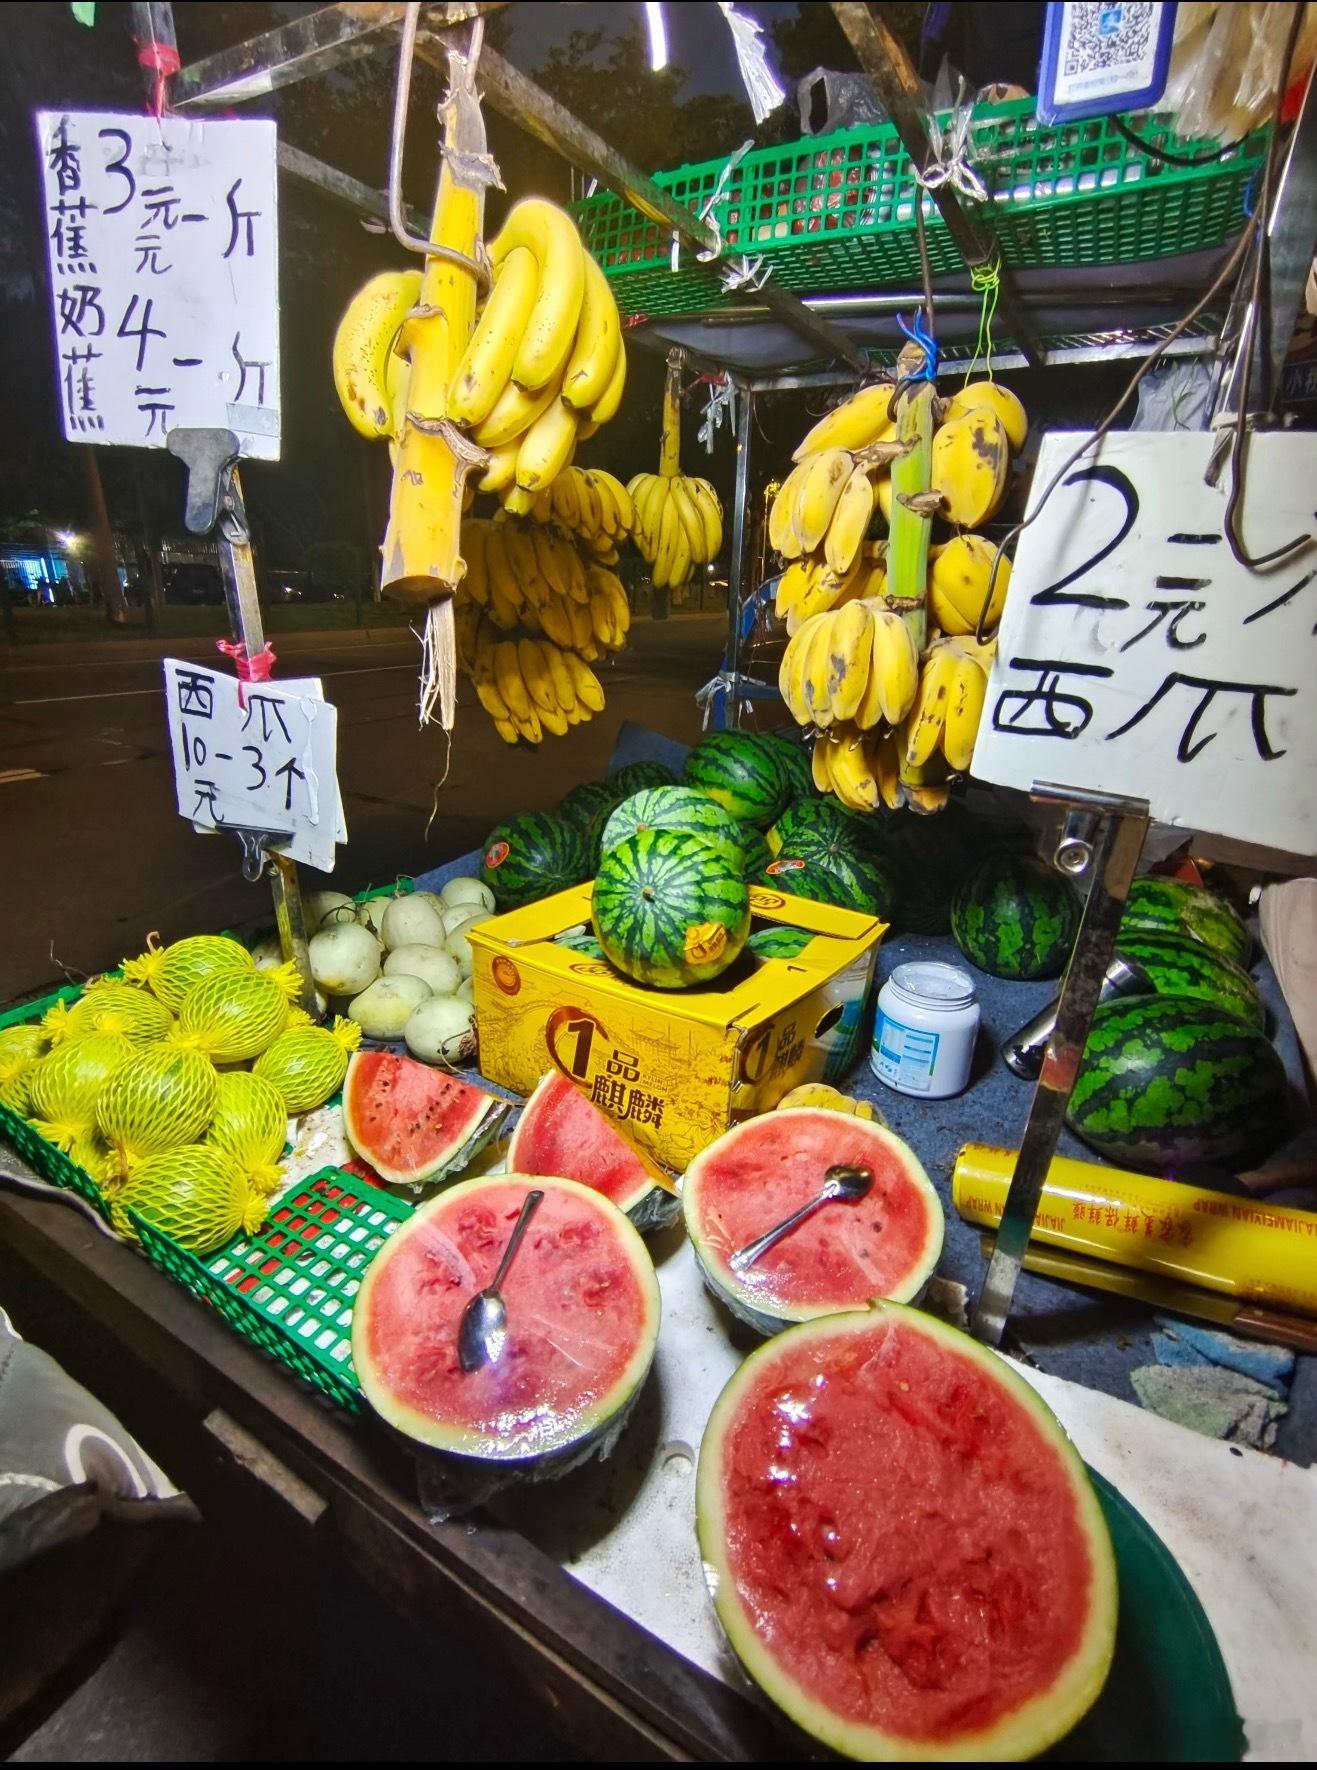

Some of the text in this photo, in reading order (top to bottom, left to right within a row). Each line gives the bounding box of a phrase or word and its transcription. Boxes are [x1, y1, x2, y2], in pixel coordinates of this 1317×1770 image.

[175, 668, 292, 743] 西瓜
[993, 657, 1299, 764] 西瓜
[192, 779, 225, 824] 元
[591, 1074, 665, 1130] 麒麟
